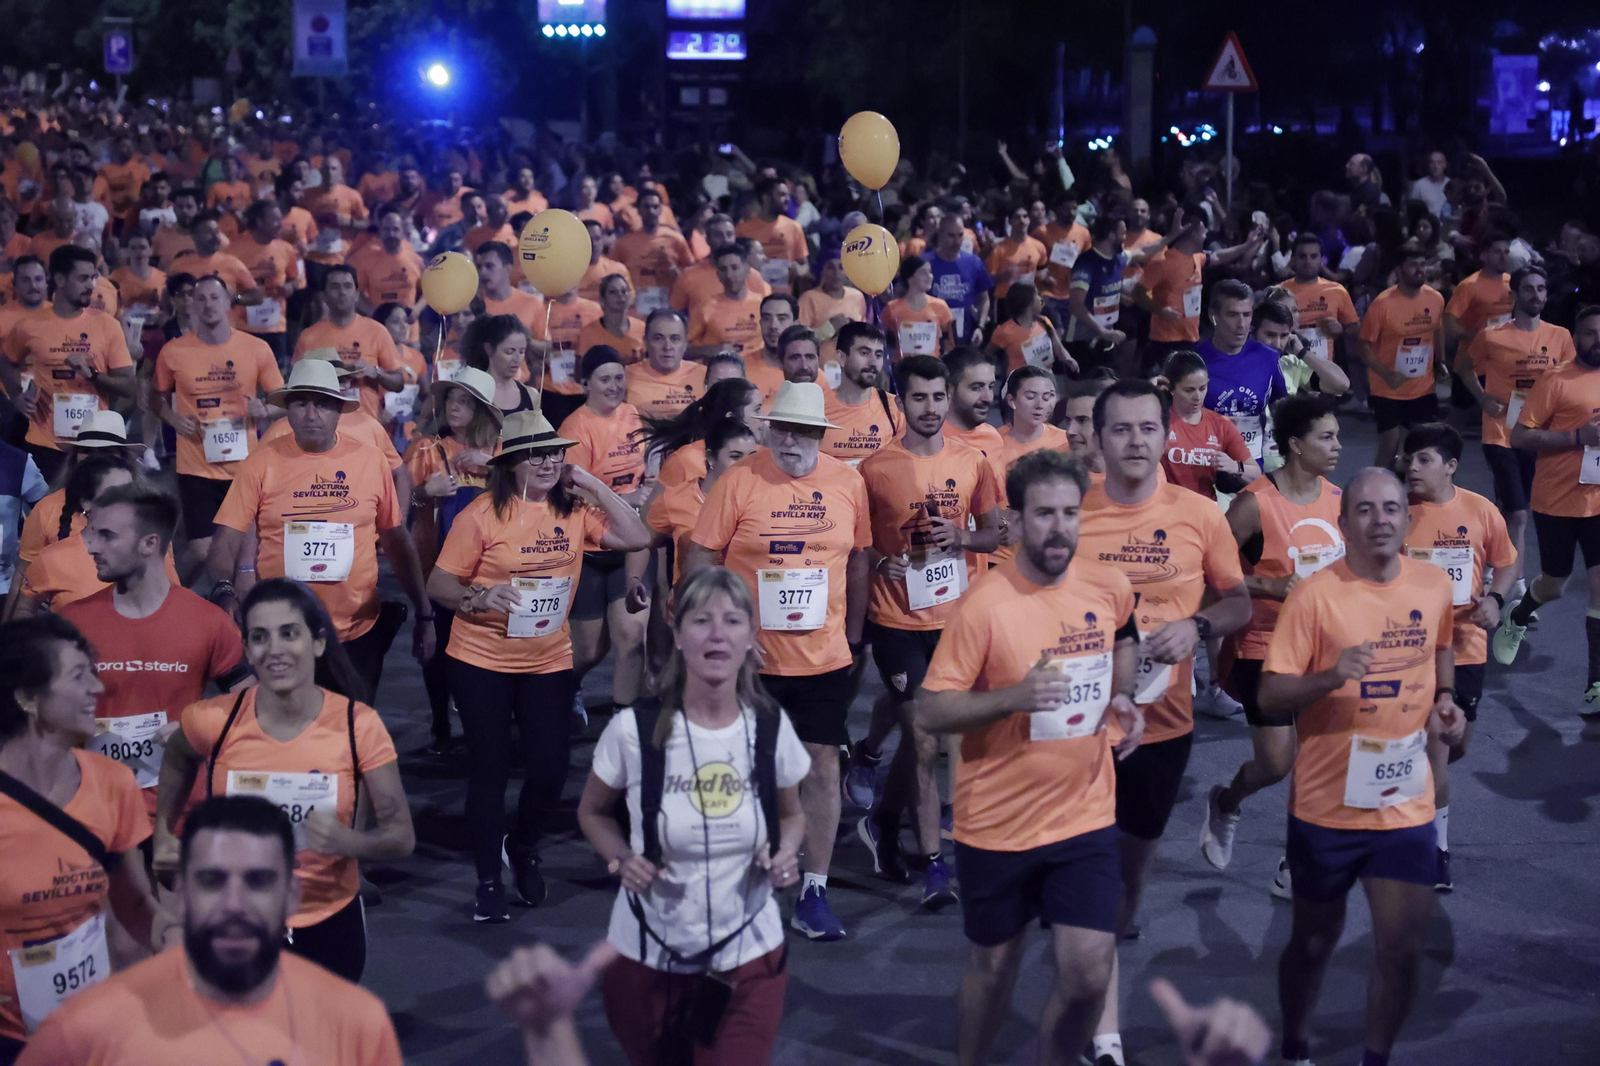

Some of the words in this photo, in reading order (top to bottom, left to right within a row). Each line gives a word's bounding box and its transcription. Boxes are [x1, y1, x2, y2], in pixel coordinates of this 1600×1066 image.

[213, 432, 239, 444] 16507
[293, 491, 328, 500] SEVILLA
[304, 542, 336, 556] 3771
[1121, 546, 1170, 554] NOCTURNA
[1098, 553, 1142, 563] SEVILLA
[925, 563, 954, 582] 8501
[779, 590, 812, 604] 3777
[531, 597, 560, 613] 3778
[1059, 630, 1105, 644] NOCTURNA
[1382, 629, 1427, 639] NOCTURNA
[1370, 640, 1401, 650] EVILLA
[144, 661, 188, 672] steria
[101, 739, 153, 760] 18033
[1375, 759, 1413, 780] 6526
[665, 774, 718, 794] Hard
[720, 773, 757, 796] Roc
[22, 885, 82, 904] SEVILLA
[53, 954, 96, 994] 9572
